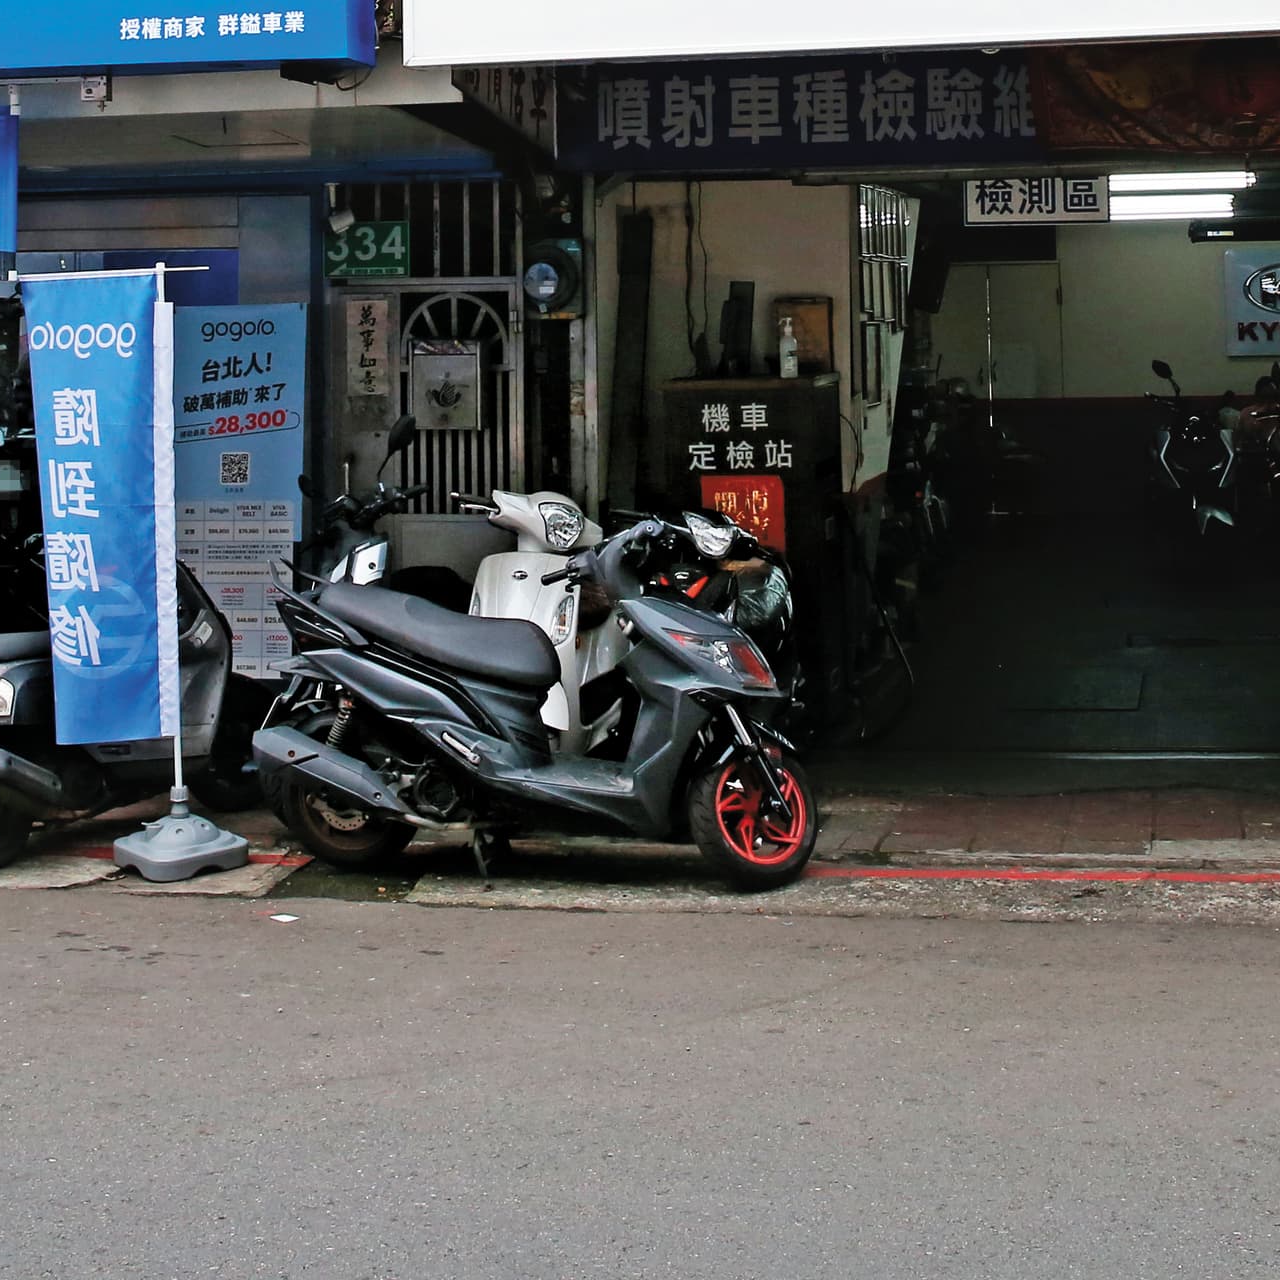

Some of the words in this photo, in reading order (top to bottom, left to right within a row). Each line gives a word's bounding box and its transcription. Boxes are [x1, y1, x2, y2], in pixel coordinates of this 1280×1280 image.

[120, 16, 206, 41] 授權商家
[218, 10, 305, 37] 群鎰車業
[975, 179, 1101, 214] 檢測區
[327, 225, 407, 262] 334
[201, 319, 276, 342] gogoro
[202, 352, 272, 384] 台北人!
[702, 402, 769, 432] 機車
[688, 440, 793, 471] 定檢站
